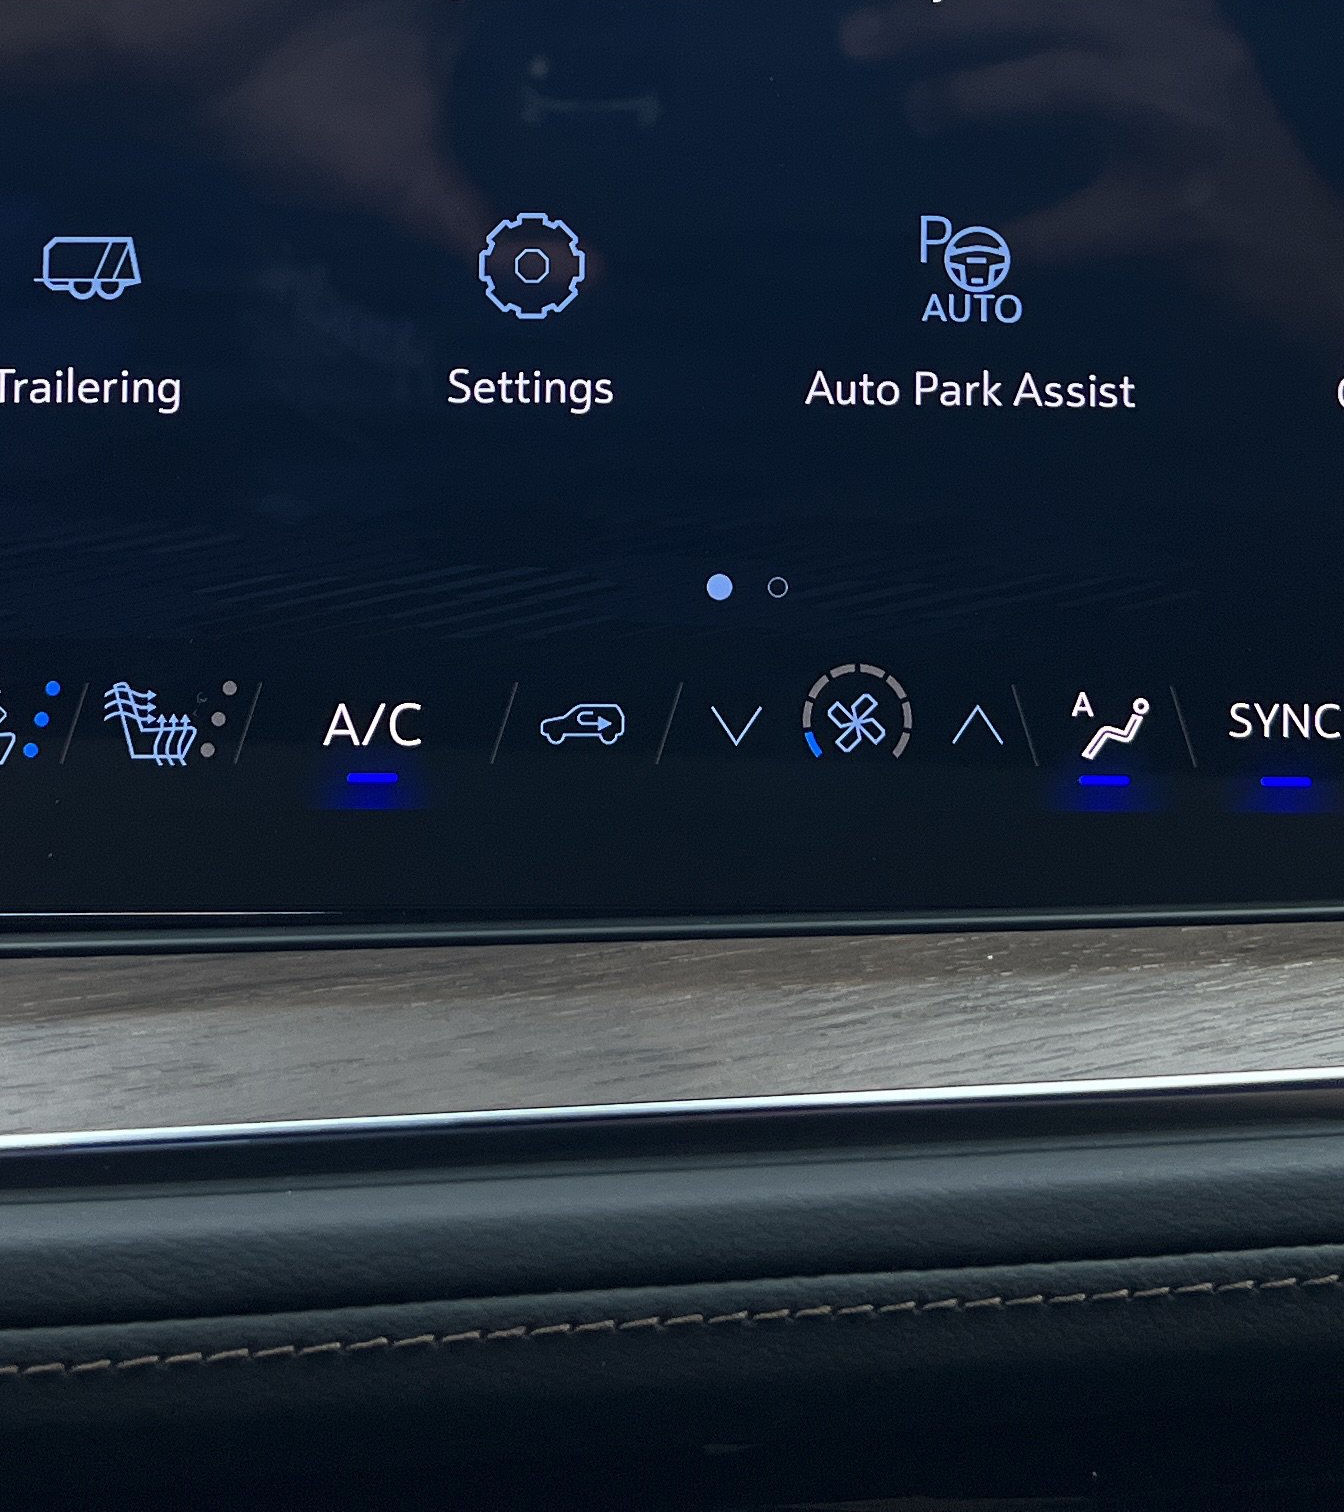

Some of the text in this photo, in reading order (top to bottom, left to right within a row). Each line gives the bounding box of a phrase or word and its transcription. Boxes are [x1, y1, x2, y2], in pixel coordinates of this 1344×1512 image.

[922, 293, 1022, 324] AUTO
[447, 368, 614, 415] Settings
[804, 369, 1136, 408] Auto Park Assist
[1071, 691, 1095, 718] A
[1228, 702, 1342, 739] SYNC
[322, 702, 422, 747] A/C
